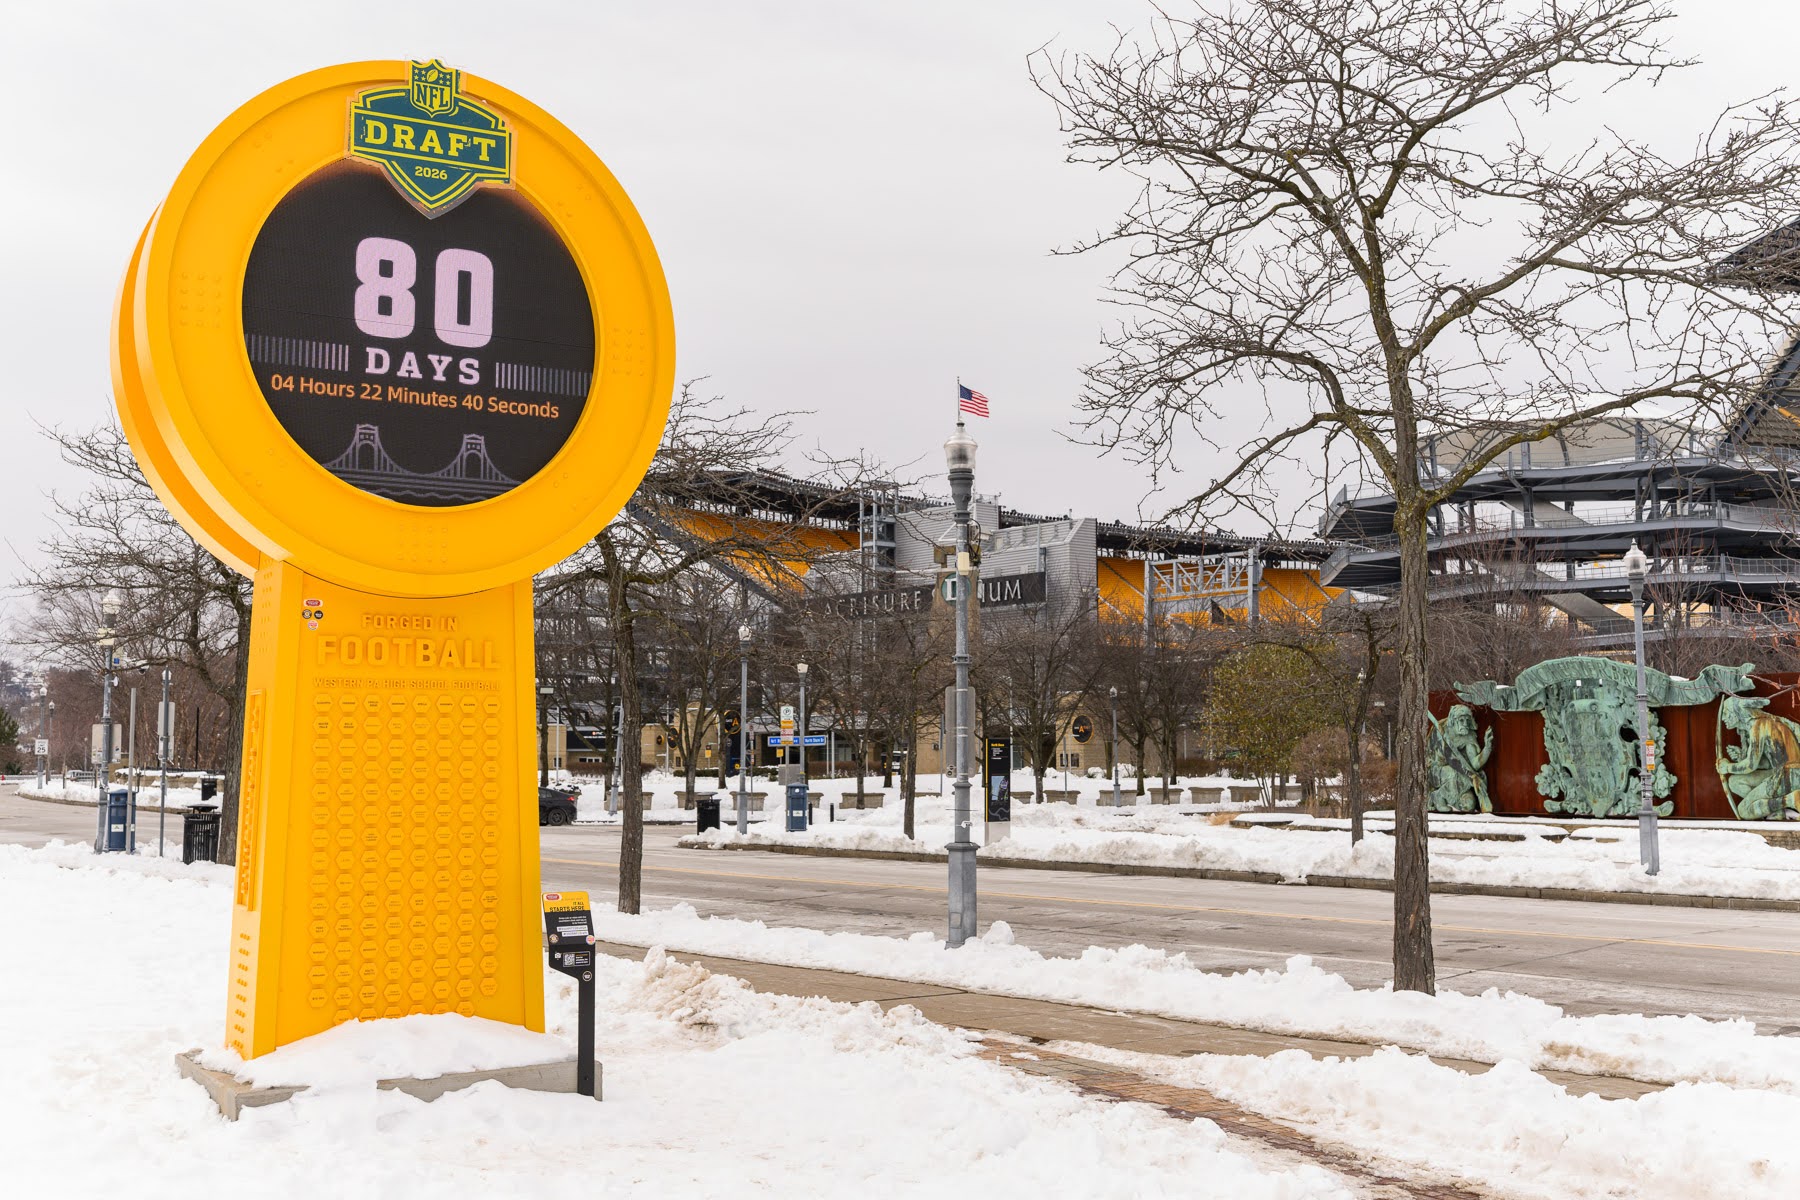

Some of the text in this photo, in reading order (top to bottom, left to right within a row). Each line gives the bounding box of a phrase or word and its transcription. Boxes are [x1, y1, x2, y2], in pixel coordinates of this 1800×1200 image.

[415, 83, 449, 110] NFL
[364, 119, 496, 162] DRAFT
[414, 165, 448, 180] 2026
[354, 236, 494, 348] 80
[365, 347, 480, 385] DAYS
[271, 373, 559, 419] 04 Hours 22 Minutes 40 Seconds
[361, 614, 457, 632] FORGED IN
[317, 635, 501, 669] FOOTBALL
[314, 677, 363, 689] WESTERN
[382, 680, 406, 690] HIGH
[410, 680, 448, 690] SCHOOL
[452, 681, 500, 692] FOOTBALL
